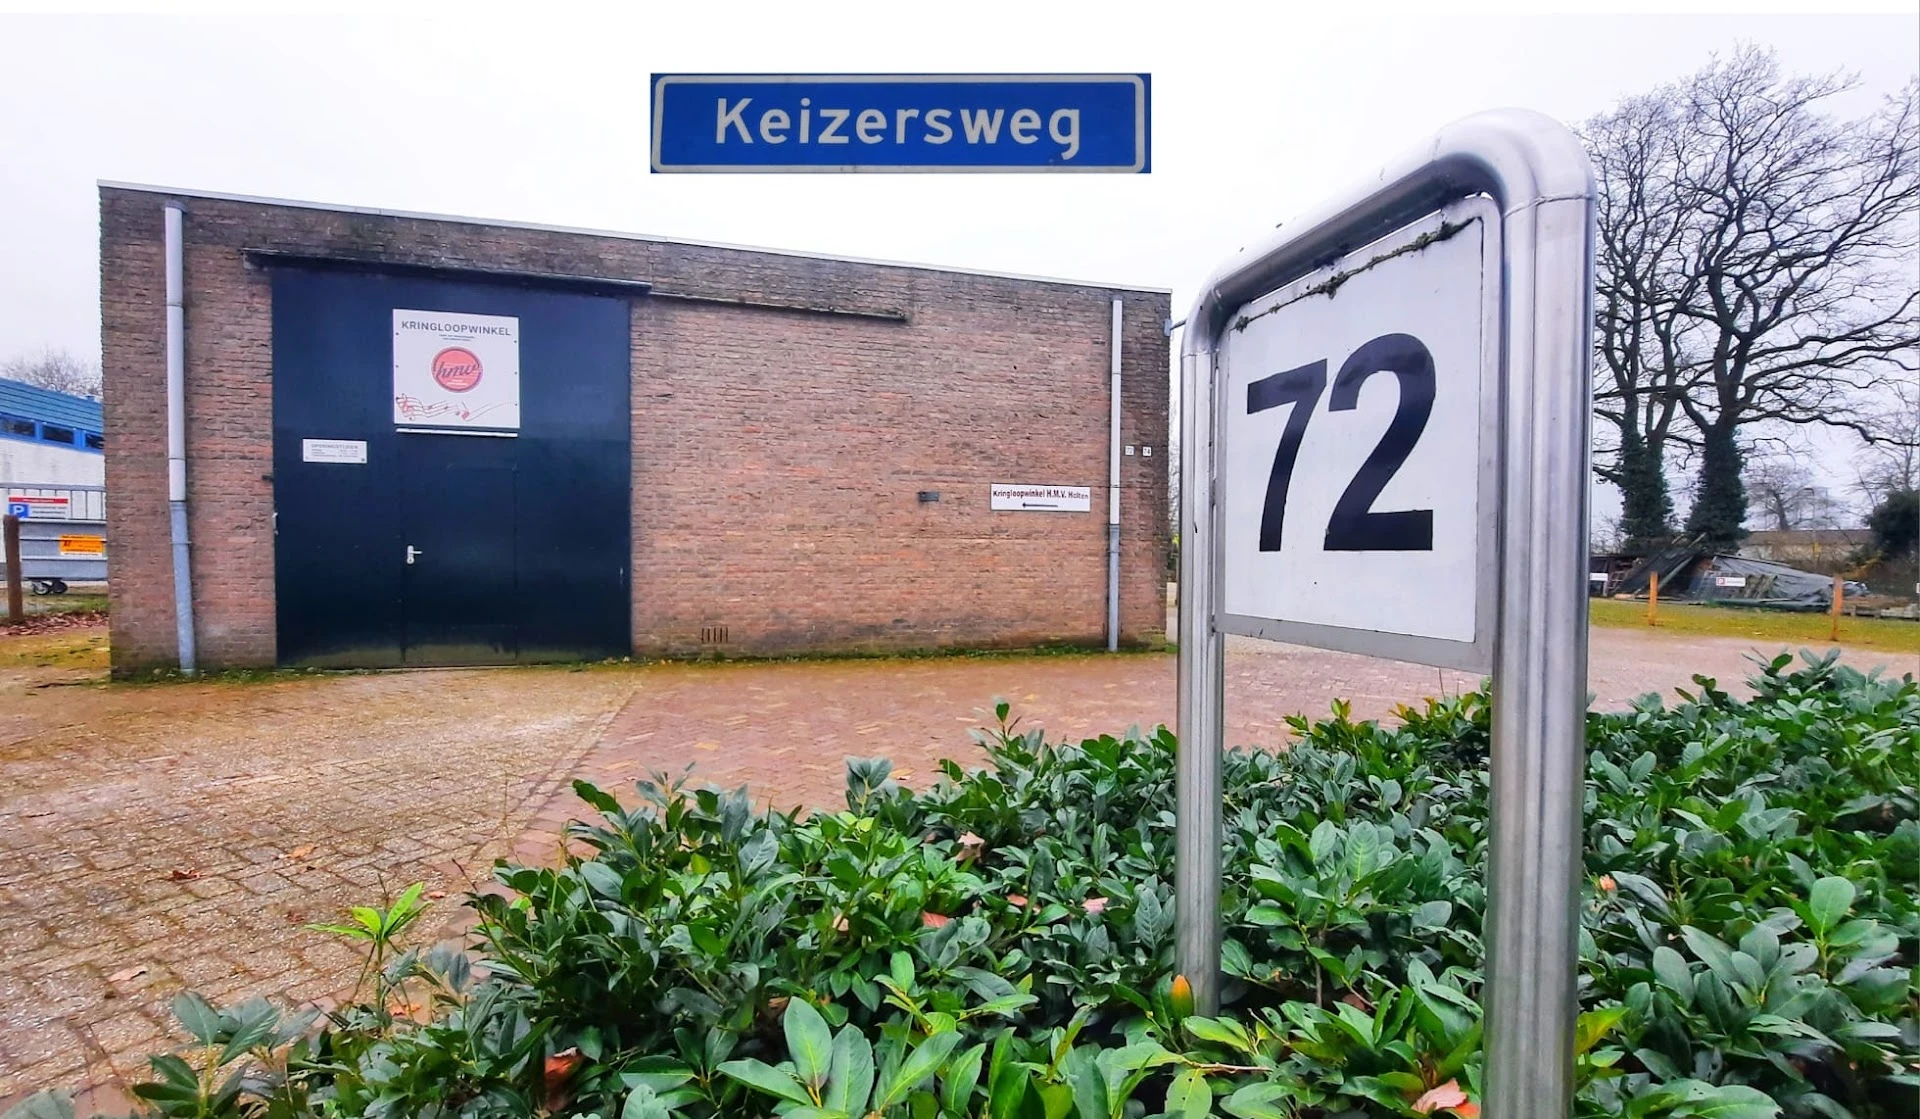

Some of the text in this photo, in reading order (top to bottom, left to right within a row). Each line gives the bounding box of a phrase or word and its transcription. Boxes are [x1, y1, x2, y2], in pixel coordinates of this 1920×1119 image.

[716, 97, 1080, 161] Keizersweg
[401, 320, 511, 336] KRINGLOOPWINKEL
[1247, 333, 1436, 552] 72
[992, 488, 1089, 500] Kringloopwinkel H.M.V. Holten
